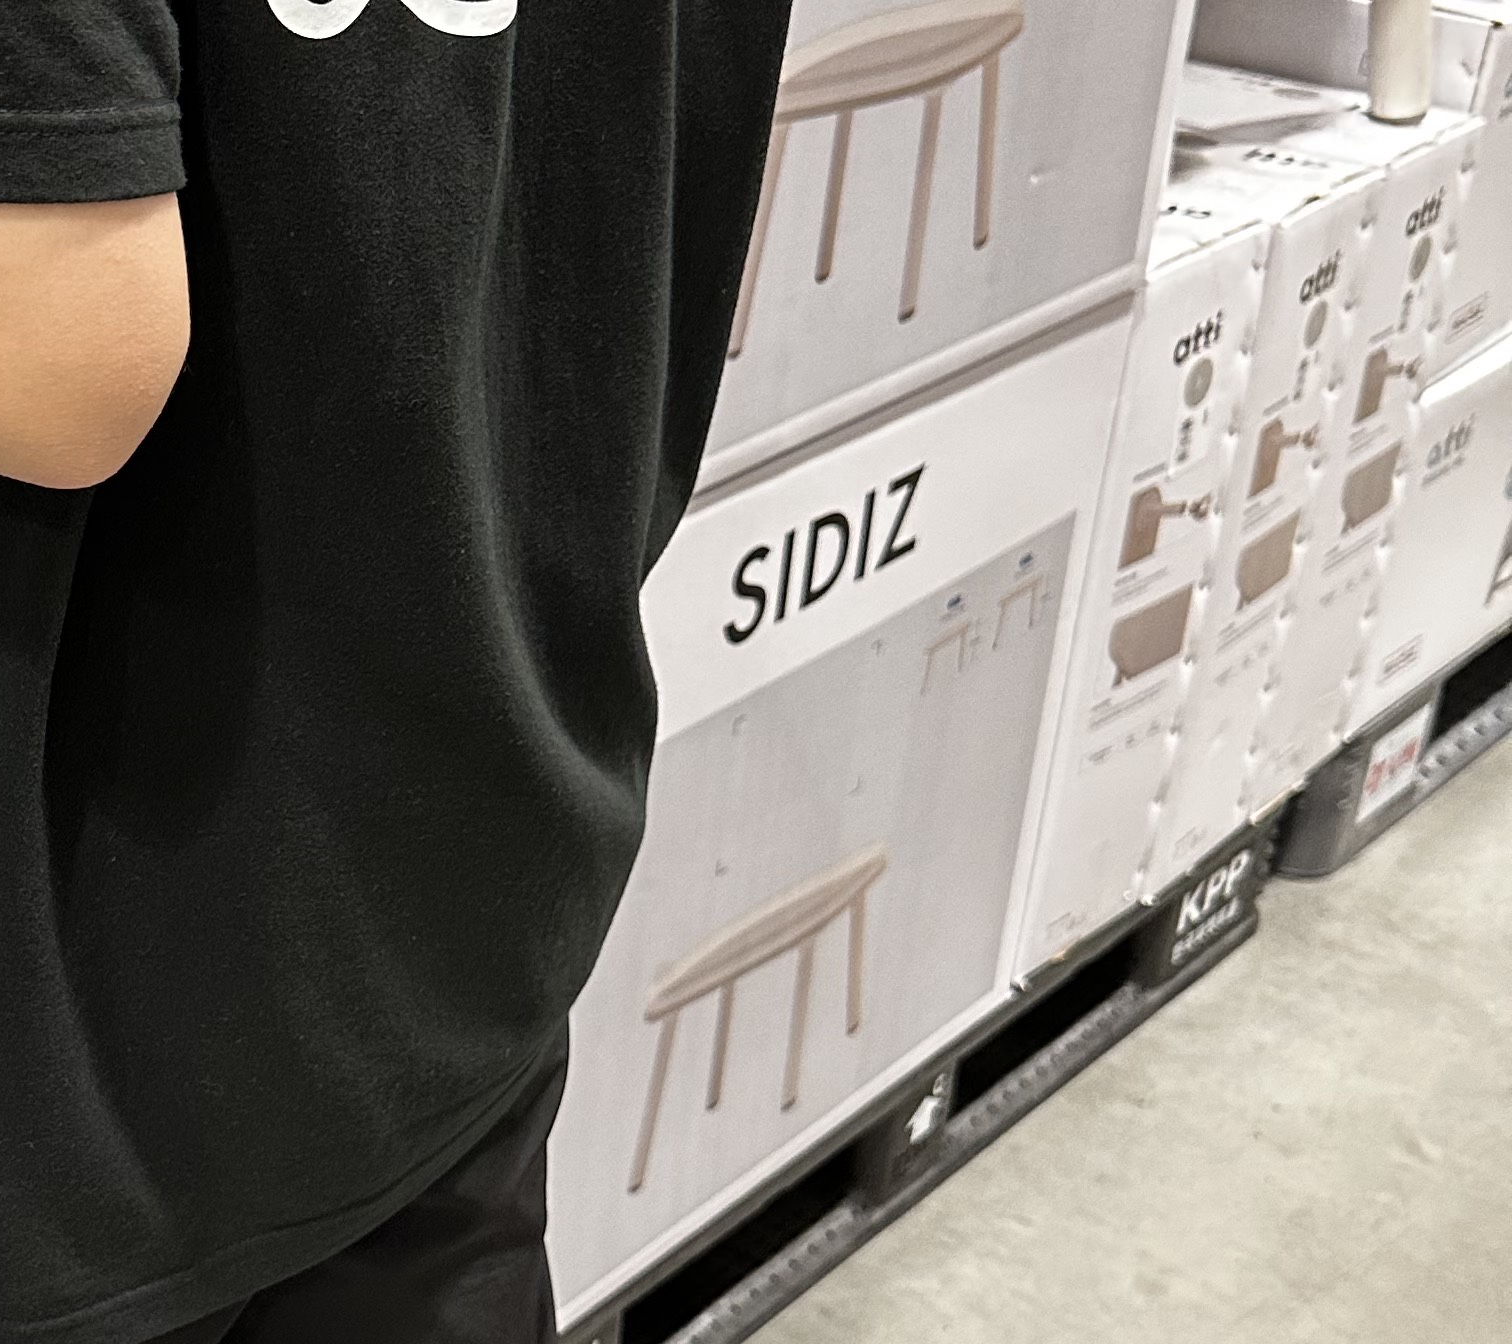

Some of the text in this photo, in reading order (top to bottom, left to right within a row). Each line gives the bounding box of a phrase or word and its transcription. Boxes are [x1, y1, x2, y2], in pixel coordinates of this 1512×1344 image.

[1299, 250, 1341, 305] atti
[1172, 309, 1223, 366] atti
[722, 462, 929, 647] SIDIZ
[1175, 847, 1250, 936] KPP
